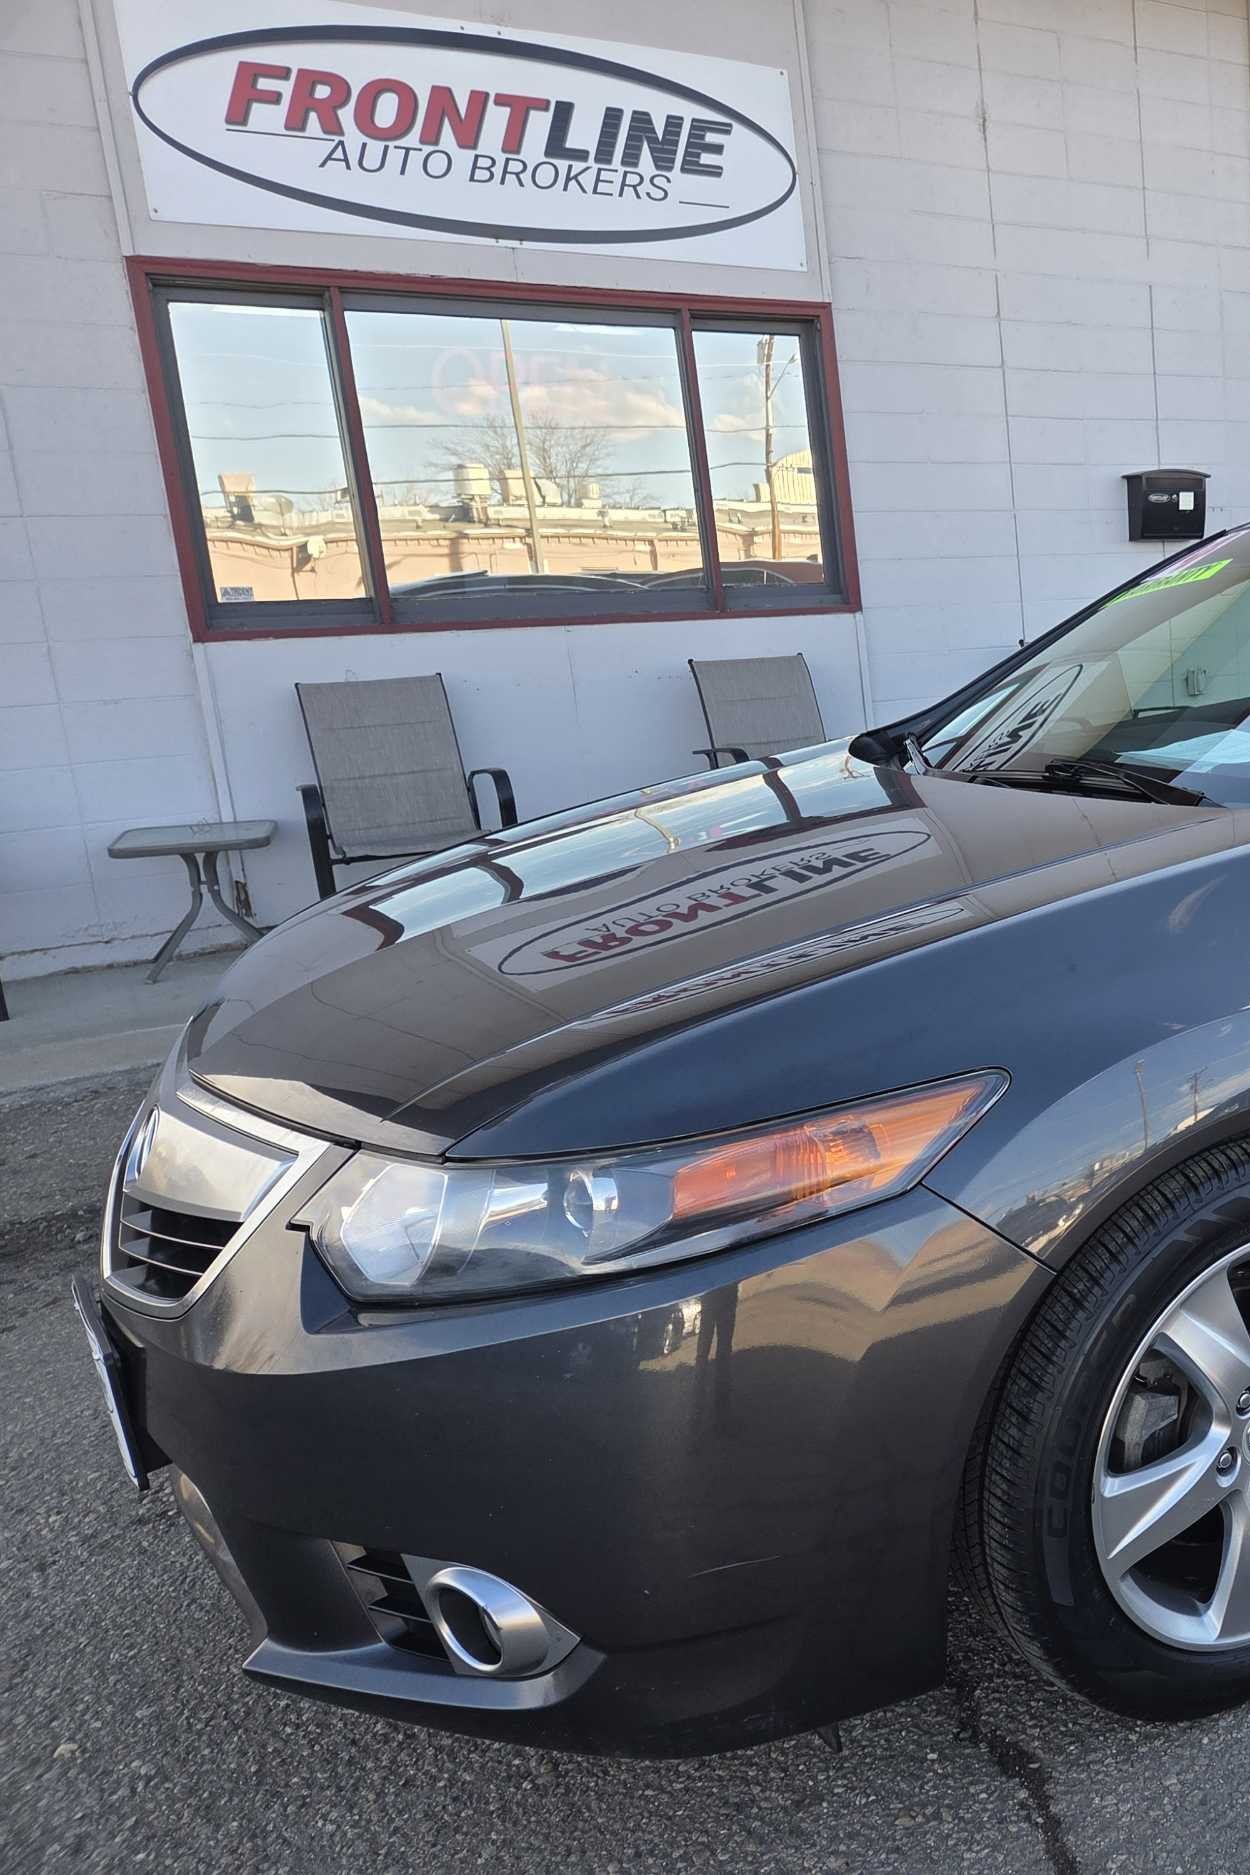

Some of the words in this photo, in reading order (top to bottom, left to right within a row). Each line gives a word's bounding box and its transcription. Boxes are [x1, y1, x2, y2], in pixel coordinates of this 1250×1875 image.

[225, 61, 733, 178] FRONTLINE
[319, 138, 453, 179] AUTO
[468, 153, 671, 201] BROKERS
